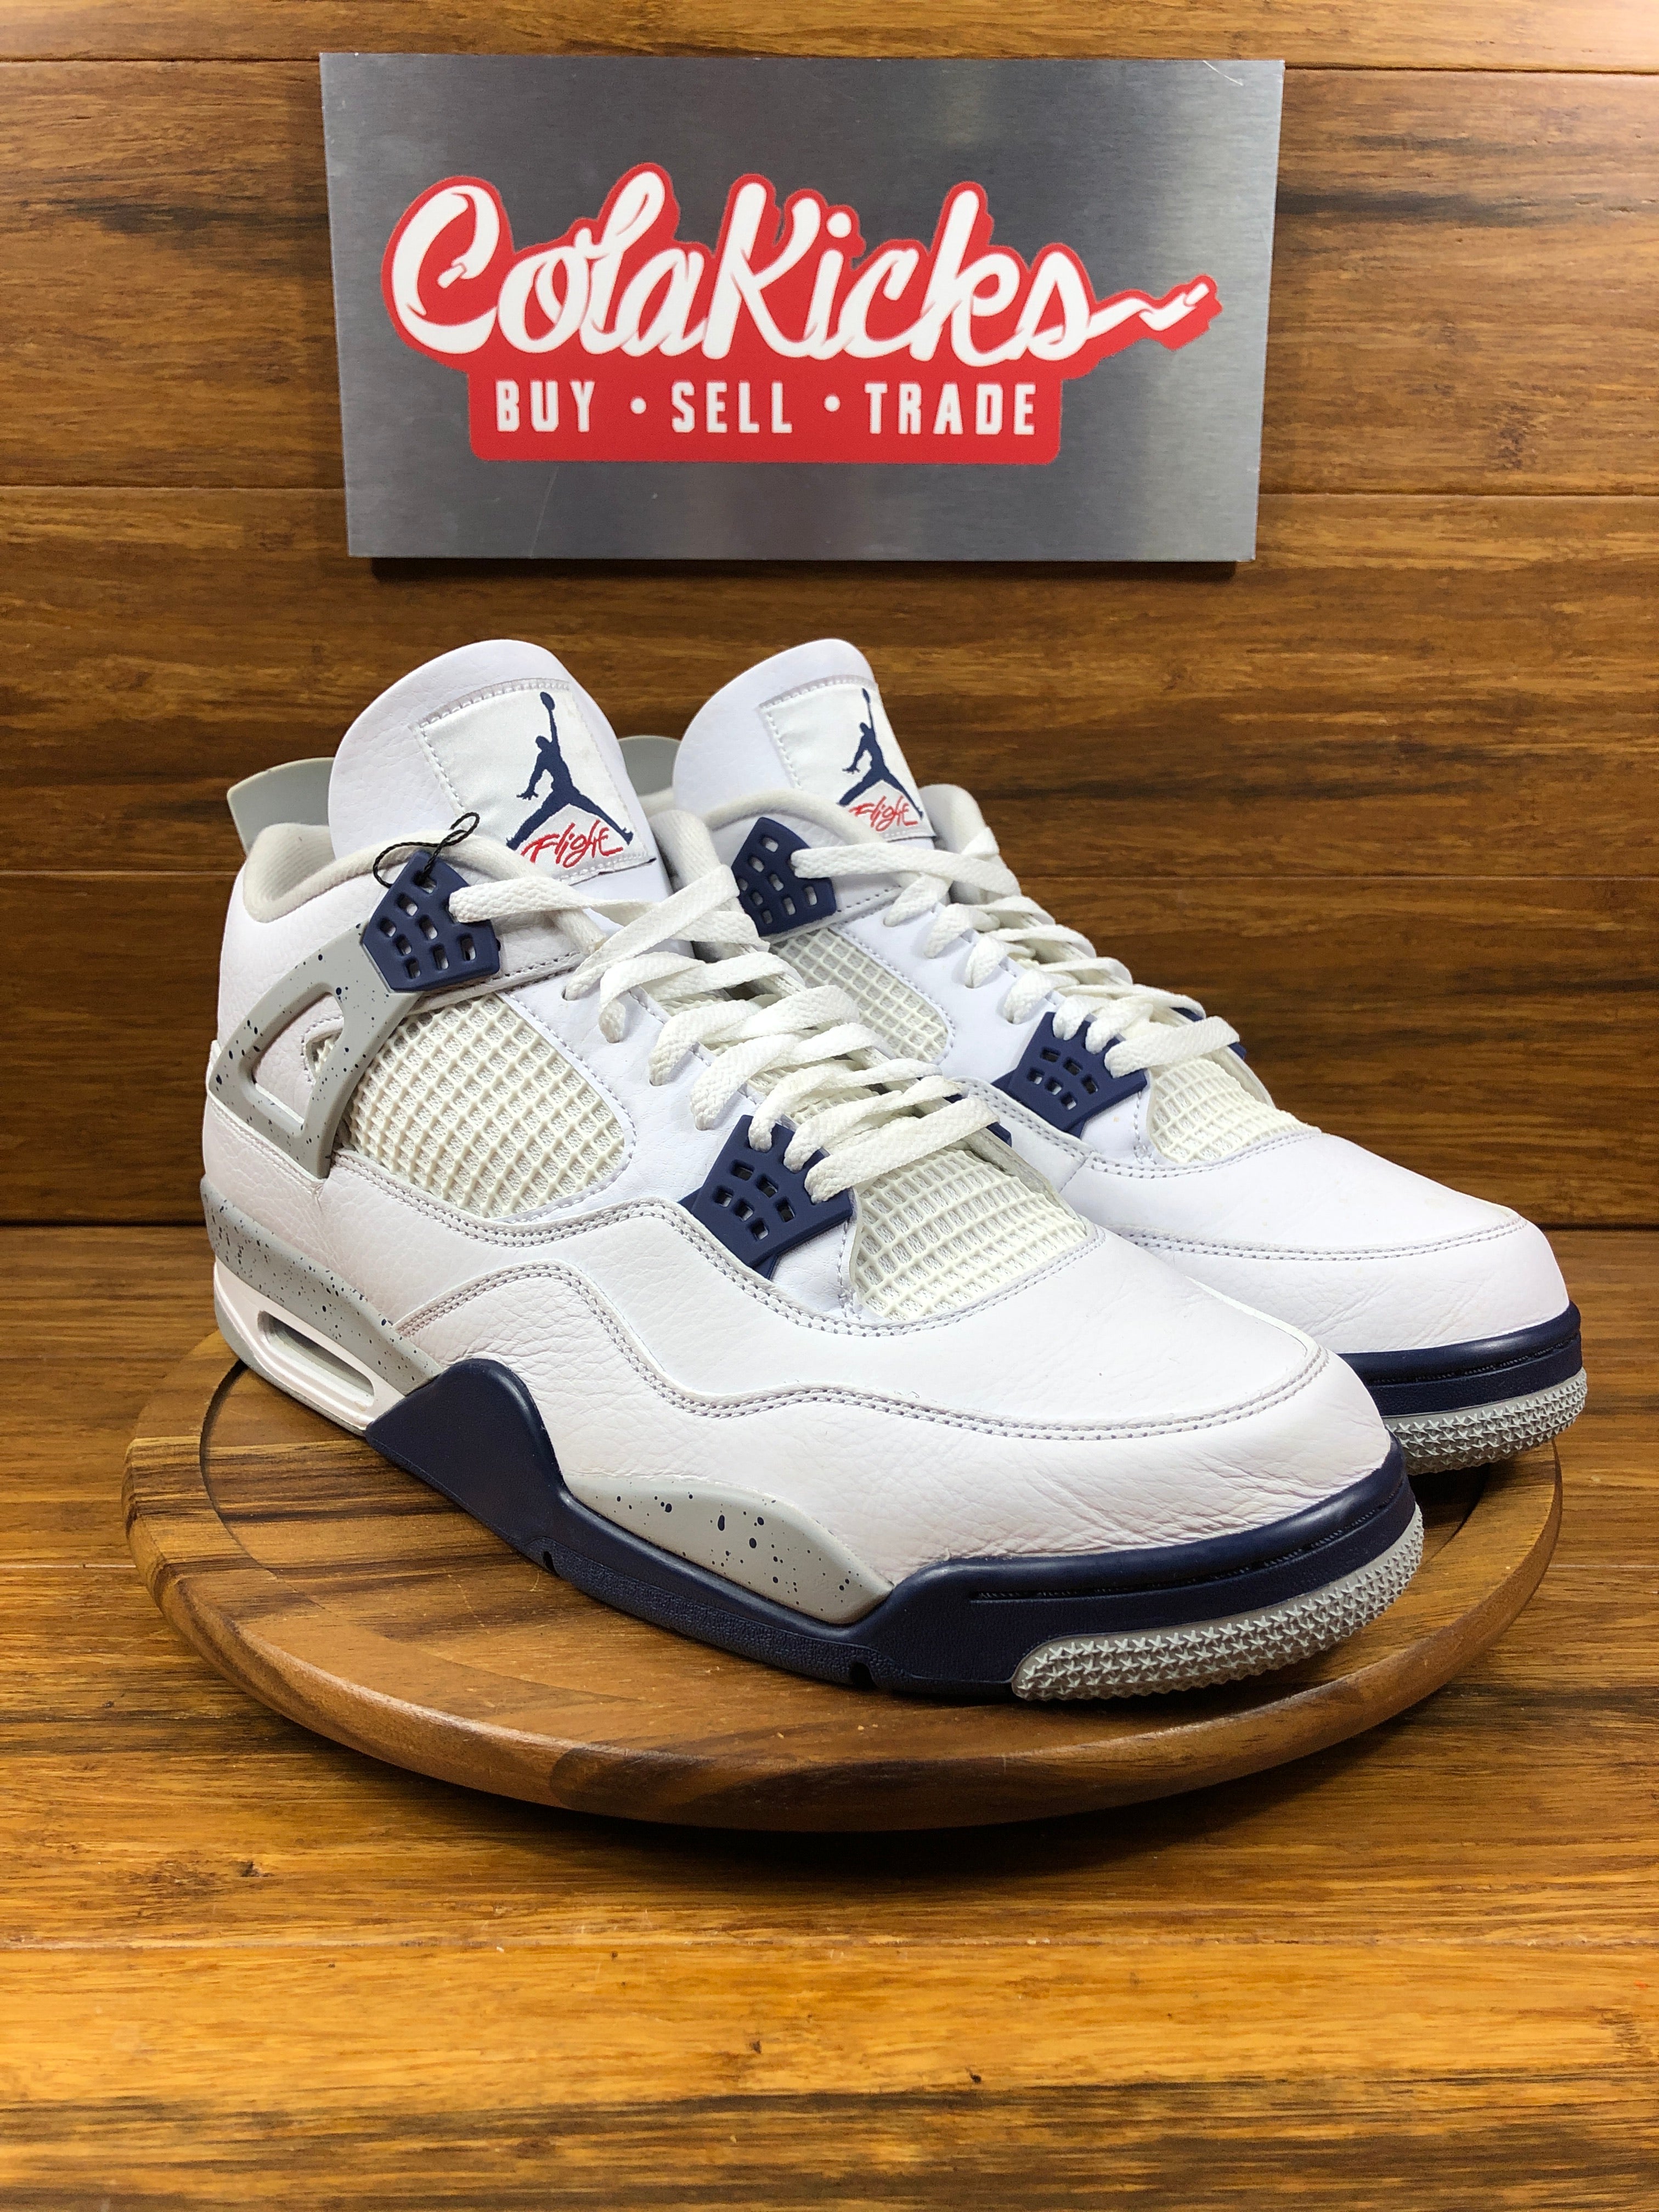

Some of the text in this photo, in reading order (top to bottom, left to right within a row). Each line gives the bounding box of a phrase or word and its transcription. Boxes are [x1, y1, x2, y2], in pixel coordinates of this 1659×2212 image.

[392, 171, 1209, 367] ColaKicks
[496, 380, 1036, 435] BUY SELL TRADE
[521, 819, 623, 868] Flight
